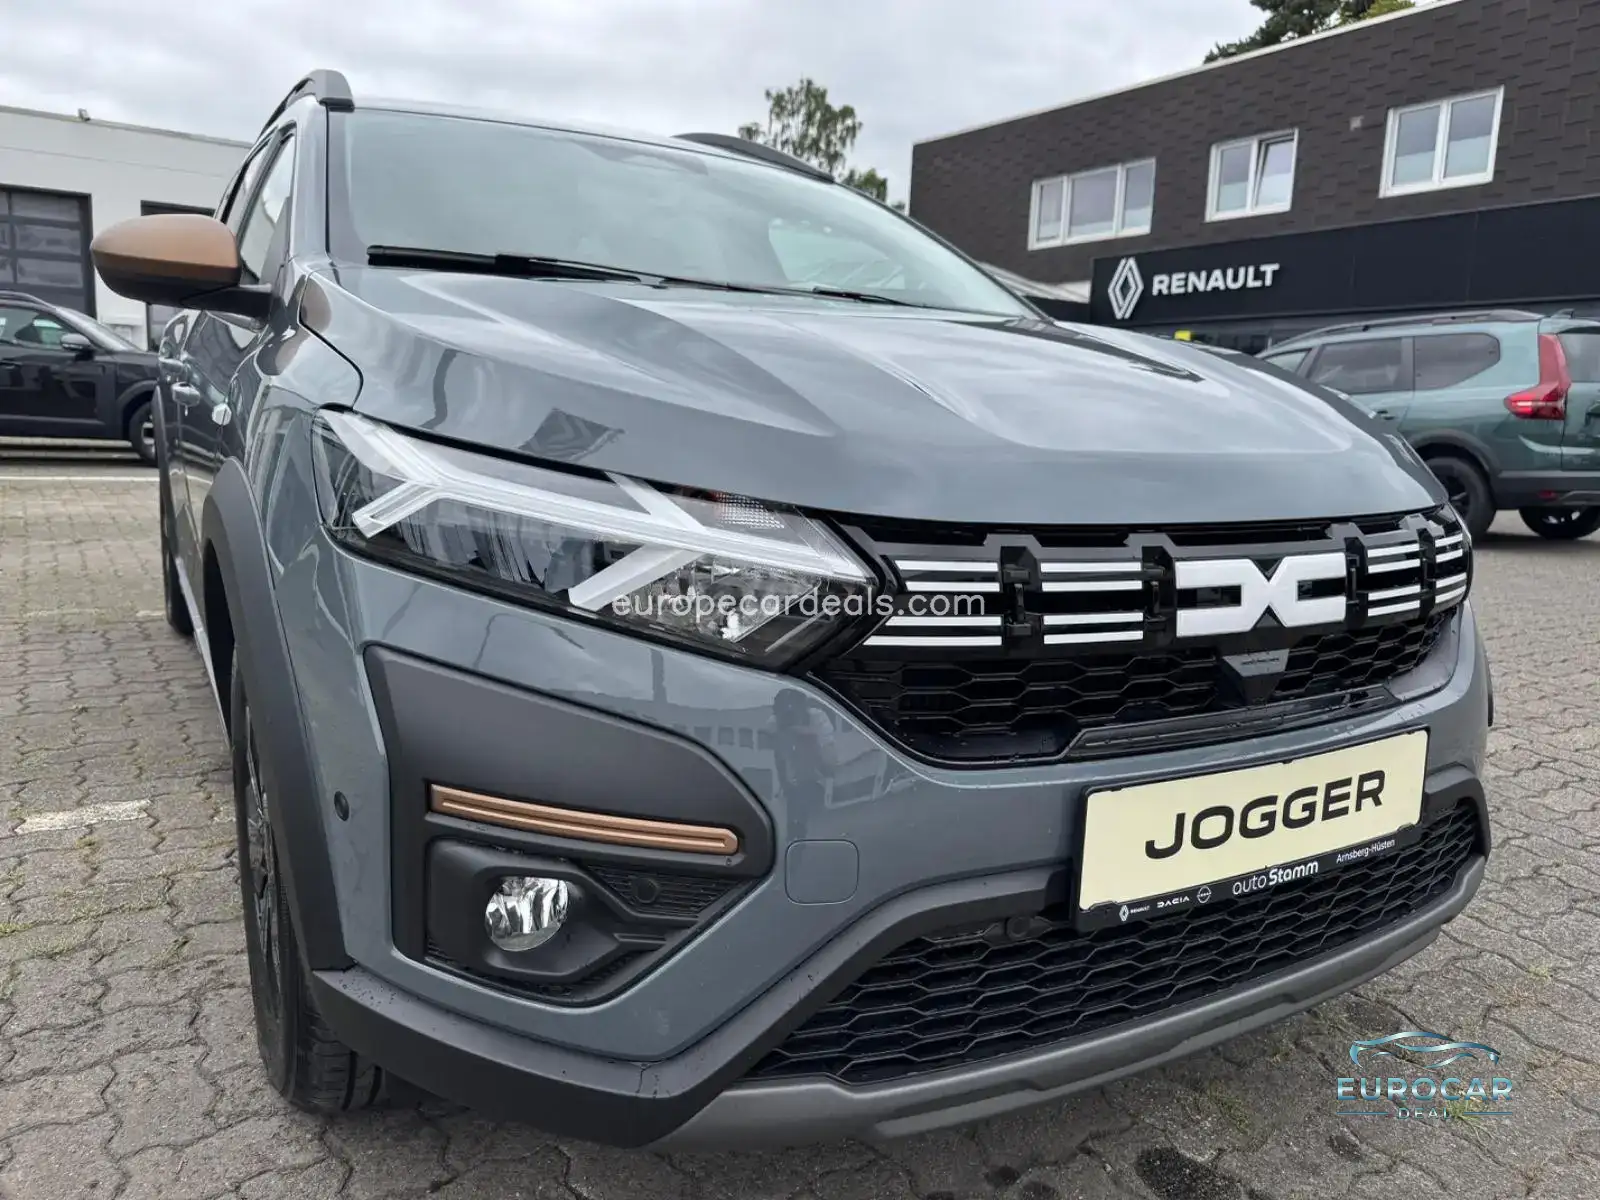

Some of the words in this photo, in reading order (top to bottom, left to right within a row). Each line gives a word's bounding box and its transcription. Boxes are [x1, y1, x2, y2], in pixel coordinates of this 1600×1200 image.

[1152, 263, 1280, 296] RENAULT
[1144, 769, 1386, 860] JOGGER
[1232, 875, 1267, 895] auto
[1268, 861, 1319, 886] Stamm
[1156, 896, 1190, 908] DACIA
